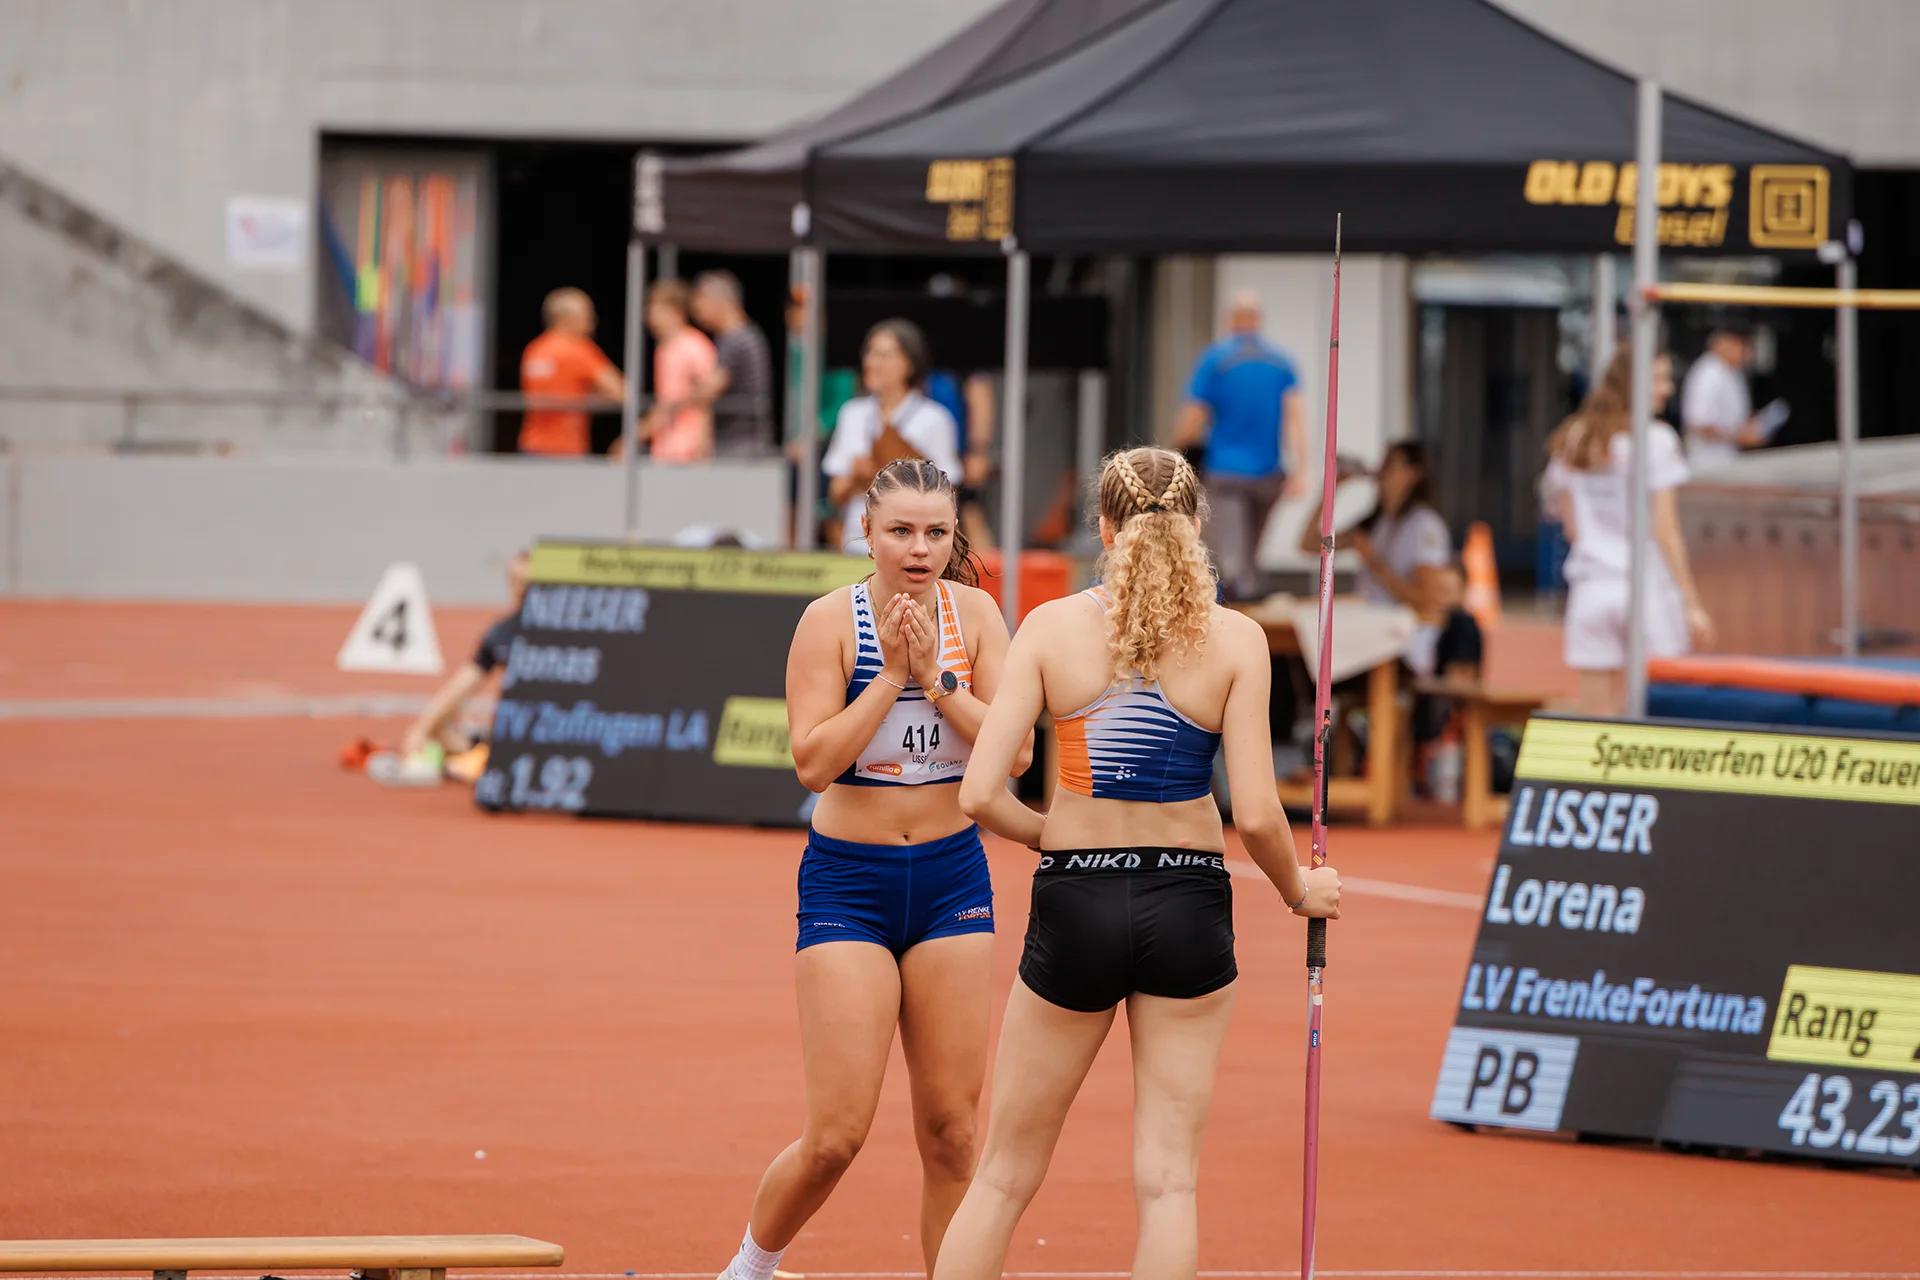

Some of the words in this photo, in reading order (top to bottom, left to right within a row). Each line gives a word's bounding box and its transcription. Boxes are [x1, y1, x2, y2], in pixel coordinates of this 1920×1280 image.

[1524, 159, 1616, 205] OLD
[1614, 206, 1729, 247] Bsel
[371, 599, 408, 650] 4
[521, 584, 649, 633] NEESER
[666, 708, 709, 749] LA
[902, 723, 941, 753] 414
[511, 754, 593, 810] 1.92
[1591, 733, 1766, 782] Speerwerfen
[1772, 743, 1825, 781] U20
[1509, 786, 1659, 855] LISSER
[1157, 853, 1224, 870] NIKE
[1486, 864, 1645, 934] Lorena
[1462, 962, 1516, 1011] LV
[1510, 967, 1767, 1035] FrenkeFortuna
[1781, 992, 1878, 1058] Rang
[1466, 1046, 1540, 1115] PB
[1777, 1072, 1920, 1157] 43.23
